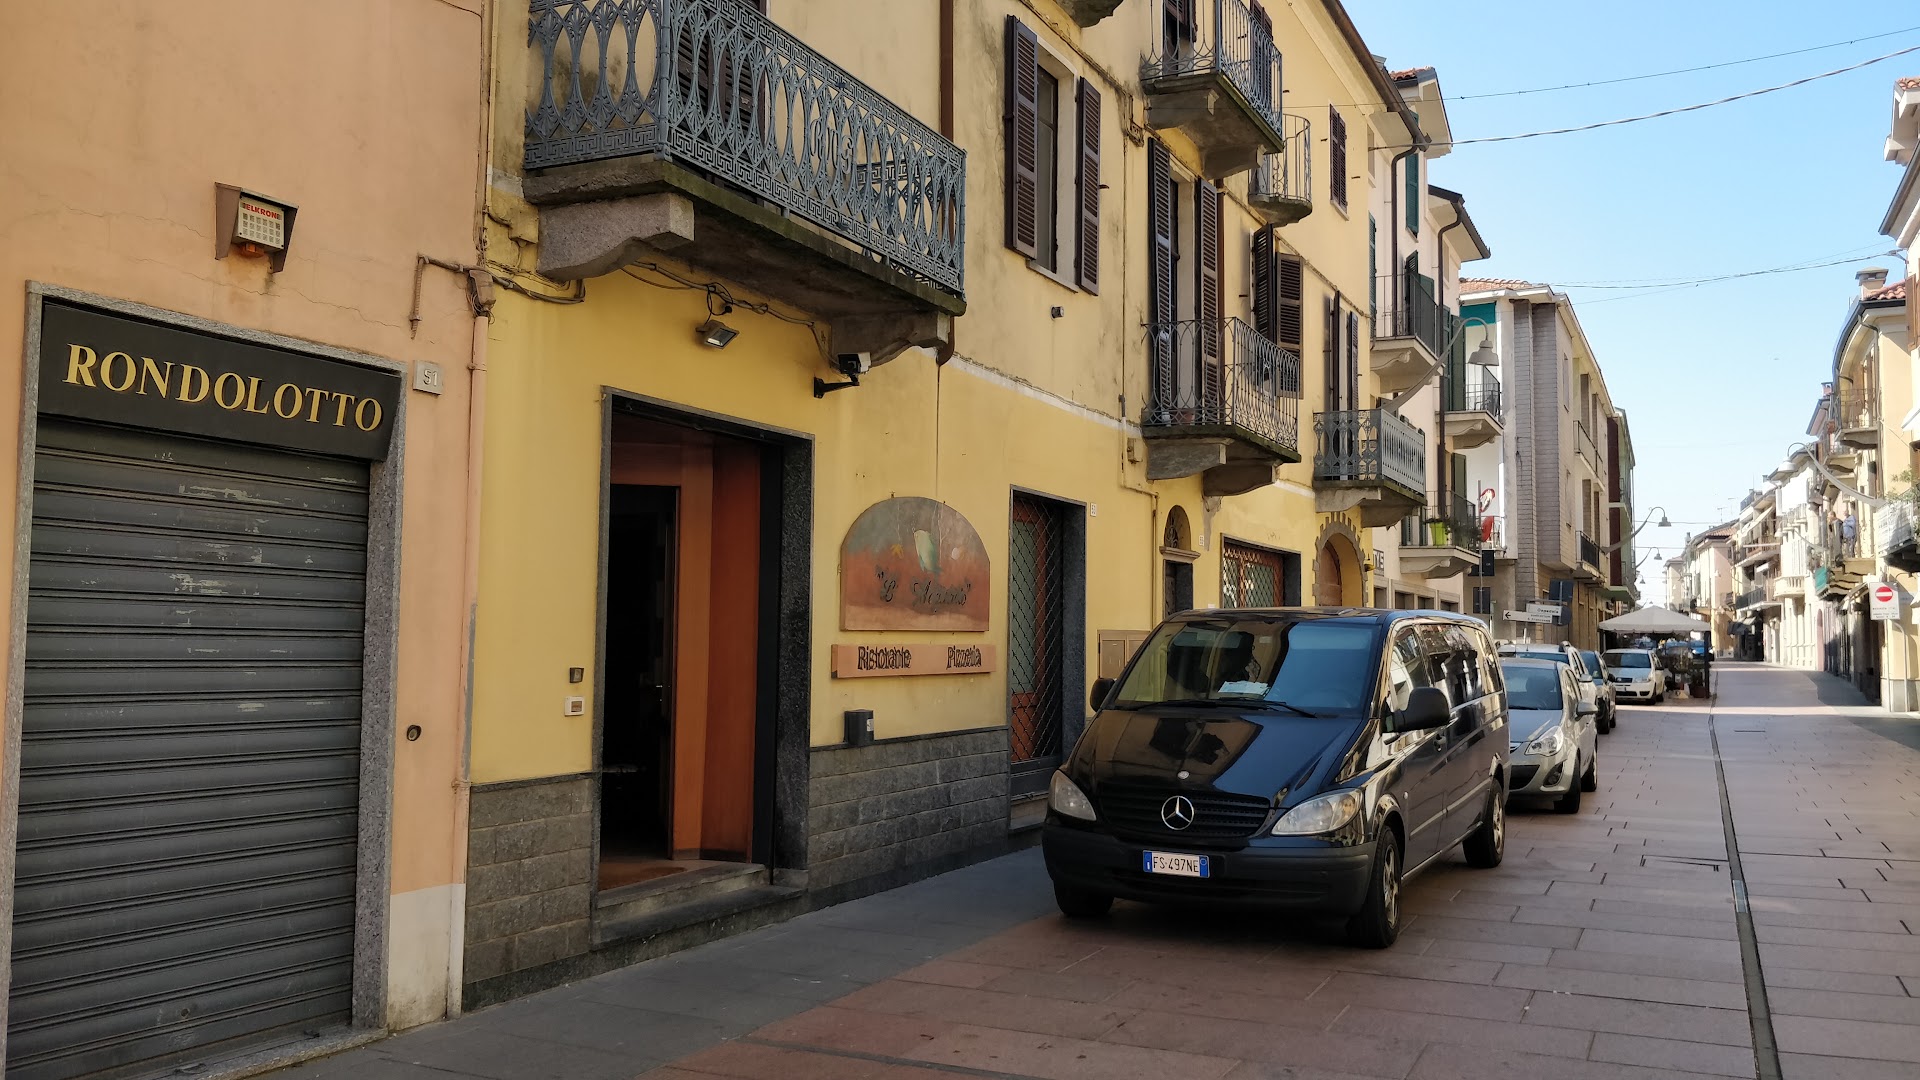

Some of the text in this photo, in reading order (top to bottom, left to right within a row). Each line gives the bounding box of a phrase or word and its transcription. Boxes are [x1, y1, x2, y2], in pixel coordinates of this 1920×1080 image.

[246, 203, 280, 220] ELKRON
[62, 343, 382, 431] RONDOLOTTO
[423, 369, 438, 386] 51
[858, 645, 981, 670] Ristorante Pizzeria
